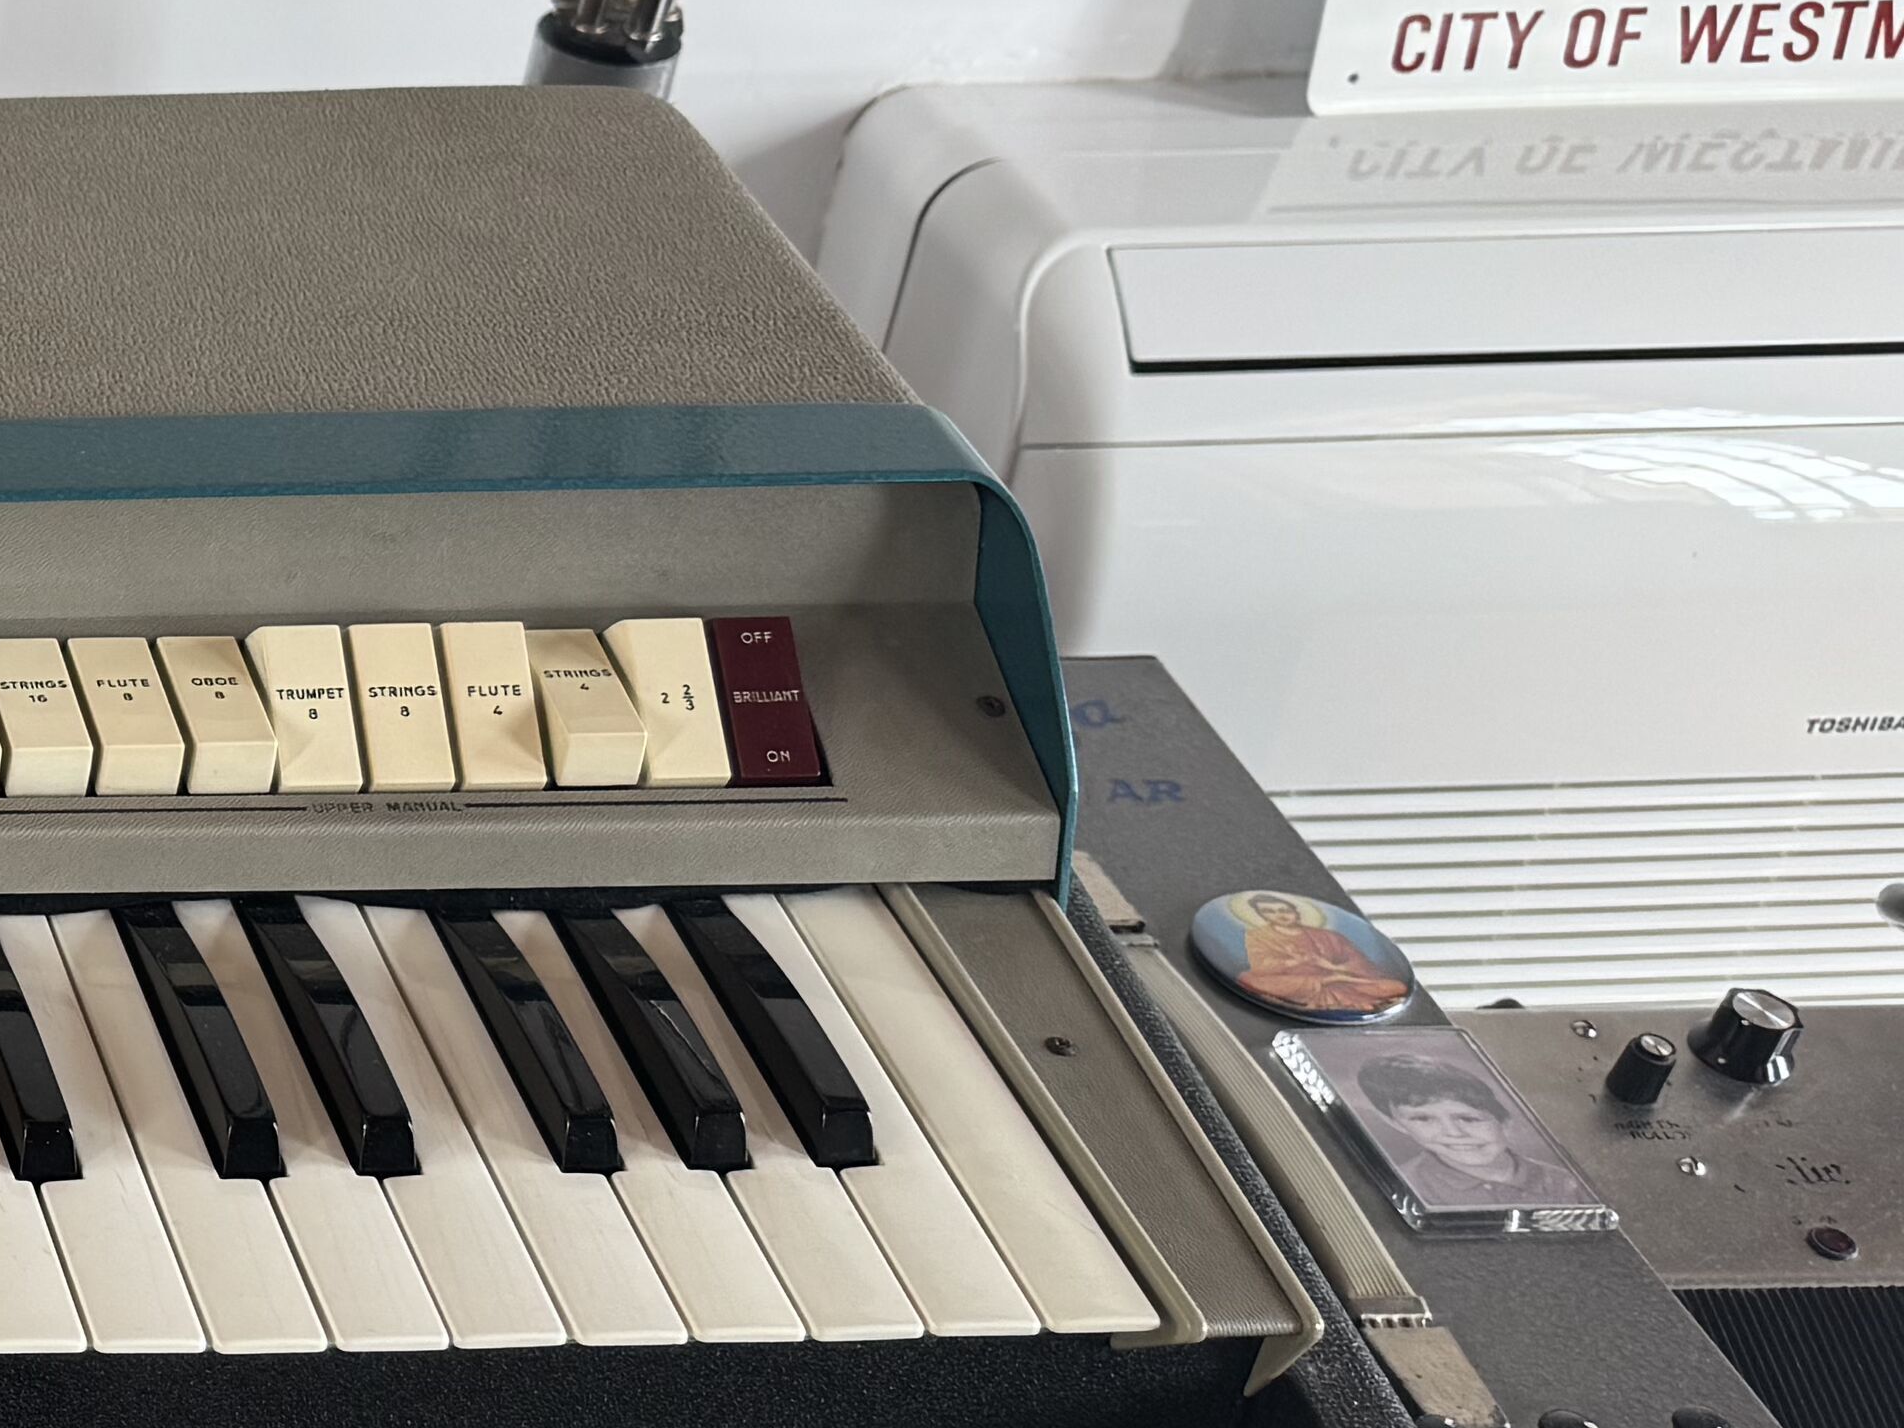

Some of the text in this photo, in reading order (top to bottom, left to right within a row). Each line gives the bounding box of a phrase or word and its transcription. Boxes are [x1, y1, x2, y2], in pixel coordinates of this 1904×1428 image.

[1392, 10, 1545, 73] CITY
[1562, 7, 1647, 69] OF
[741, 631, 773, 645] OFF
[543, 668, 612, 679] STRINGS
[0, 680, 67, 690] STRINGS
[96, 678, 150, 689] FLUTE
[190, 677, 239, 687] OBOE
[275, 687, 344, 701] TRUMPET
[367, 685, 438, 698] STRINGS
[466, 684, 522, 697] FLUTE
[733, 690, 800, 704] BRILLIANT
[29, 694, 48, 704] 16
[308, 708, 318, 720] 8
[400, 705, 410, 717] 8
[492, 705, 503, 716] 4
[1806, 716, 1903, 733] TOSHIBA
[766, 749, 791, 763] ON
[312, 800, 462, 815] UPPER MANUAL
